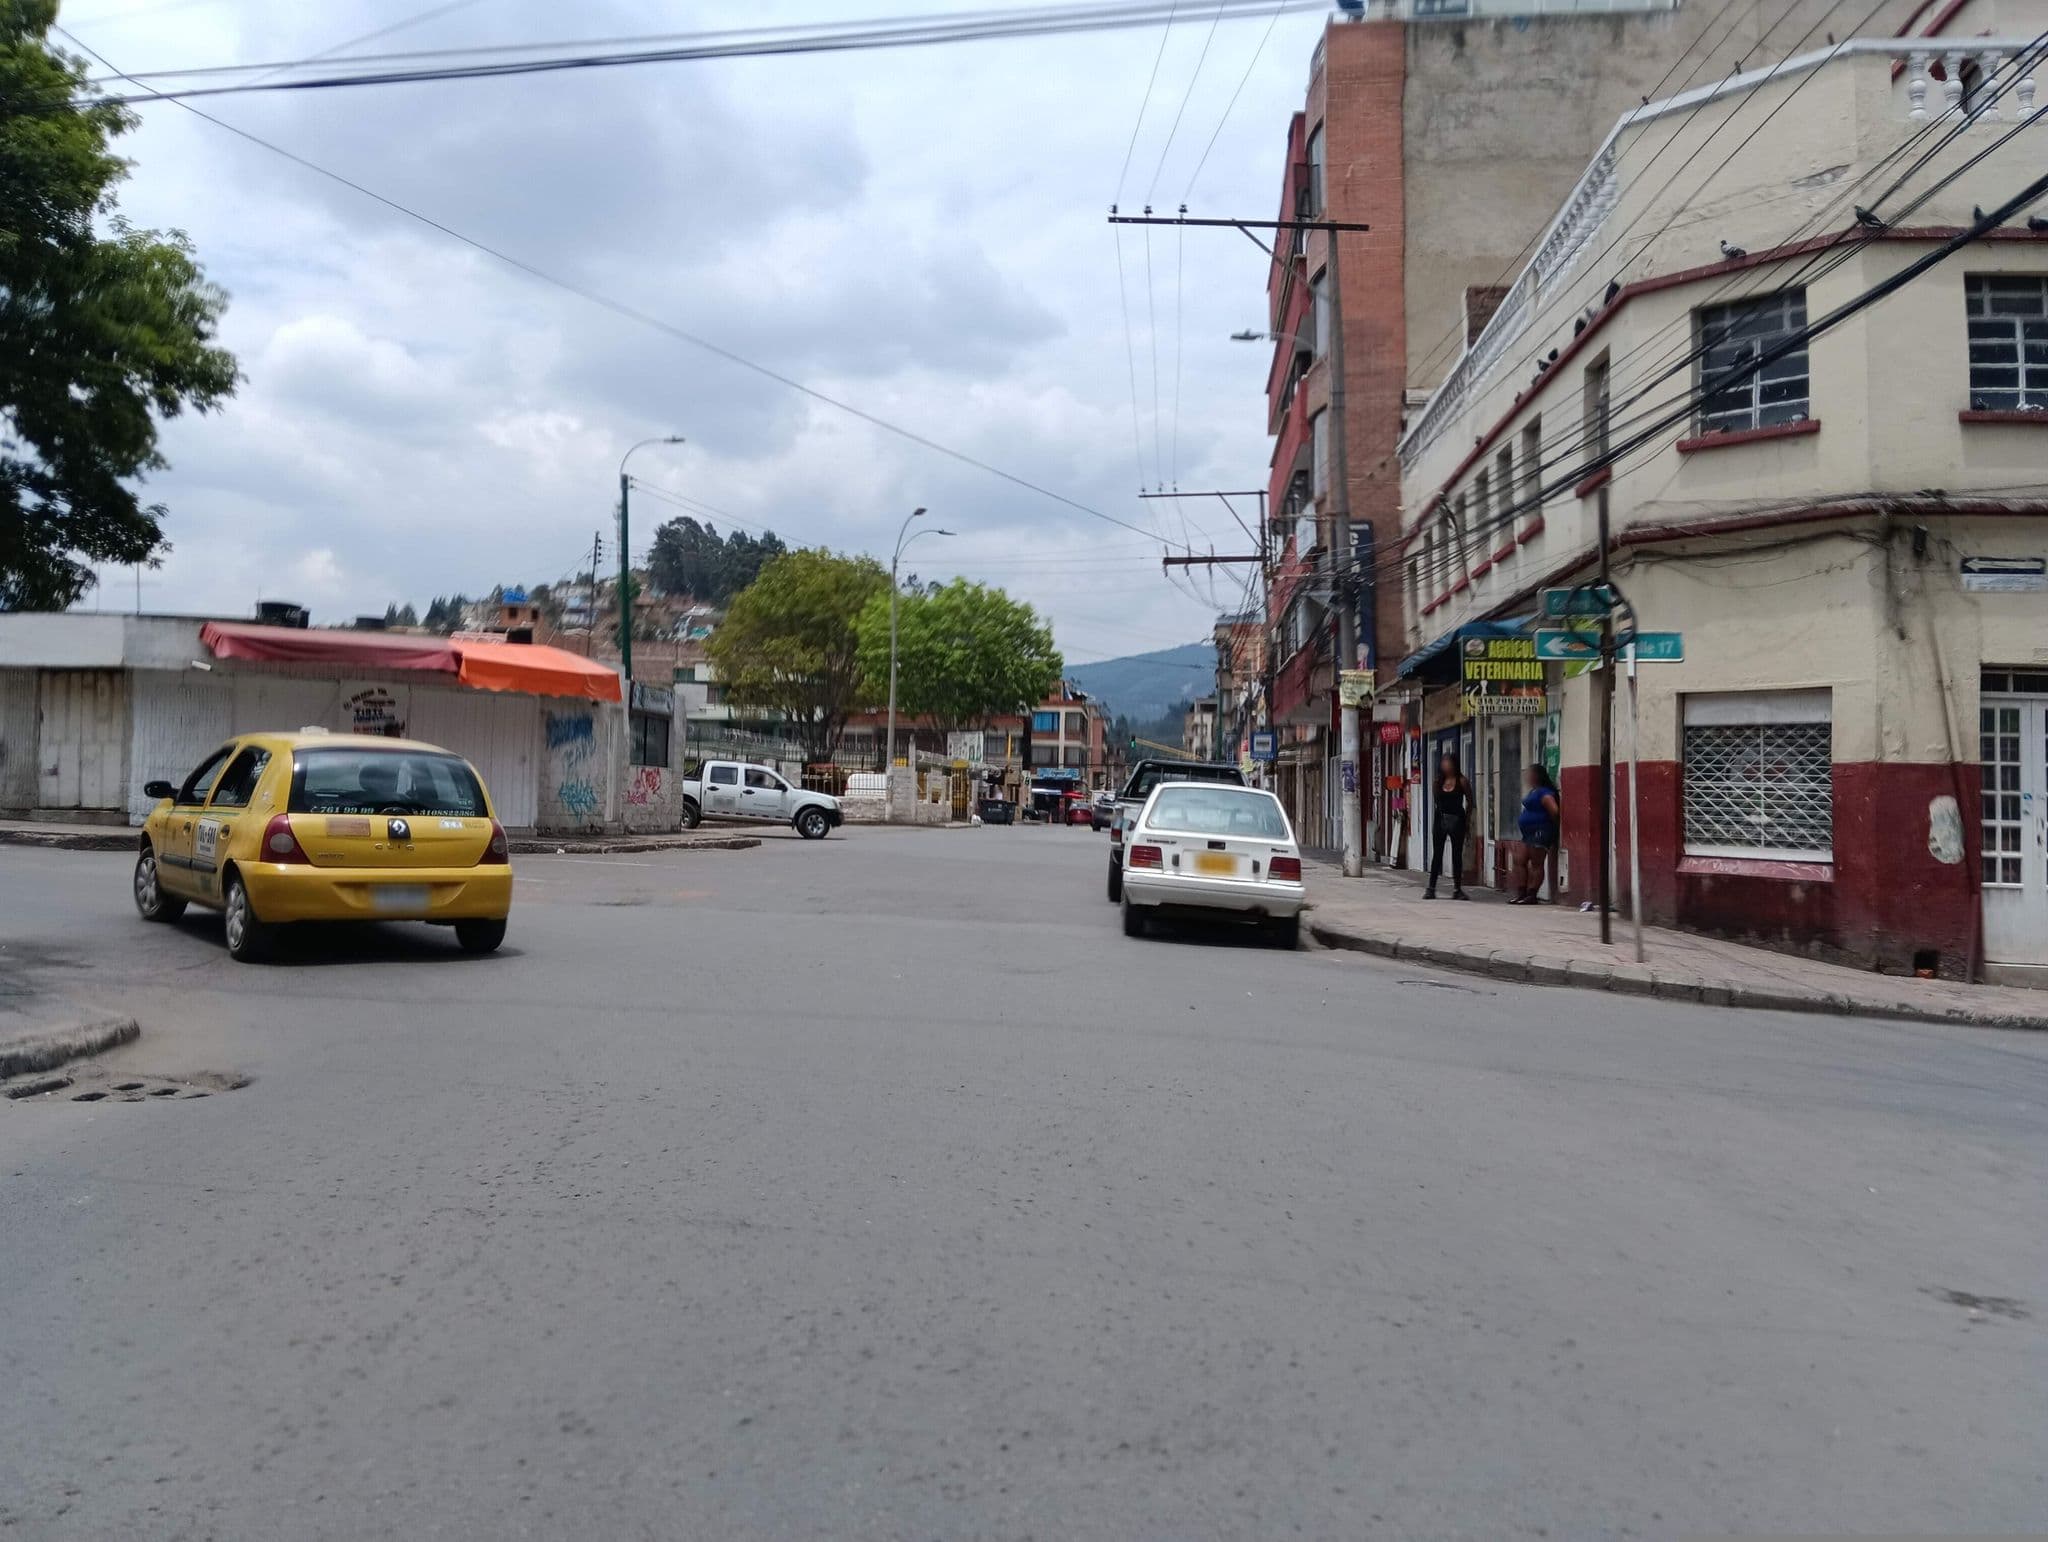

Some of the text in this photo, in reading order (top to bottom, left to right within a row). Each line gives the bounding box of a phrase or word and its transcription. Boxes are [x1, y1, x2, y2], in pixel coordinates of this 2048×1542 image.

[1488, 640, 1536, 658] AGRICOL
[1658, 641, 1674, 654] 17
[1465, 661, 1544, 680] VETERINARIA
[320, 806, 341, 814] 761
